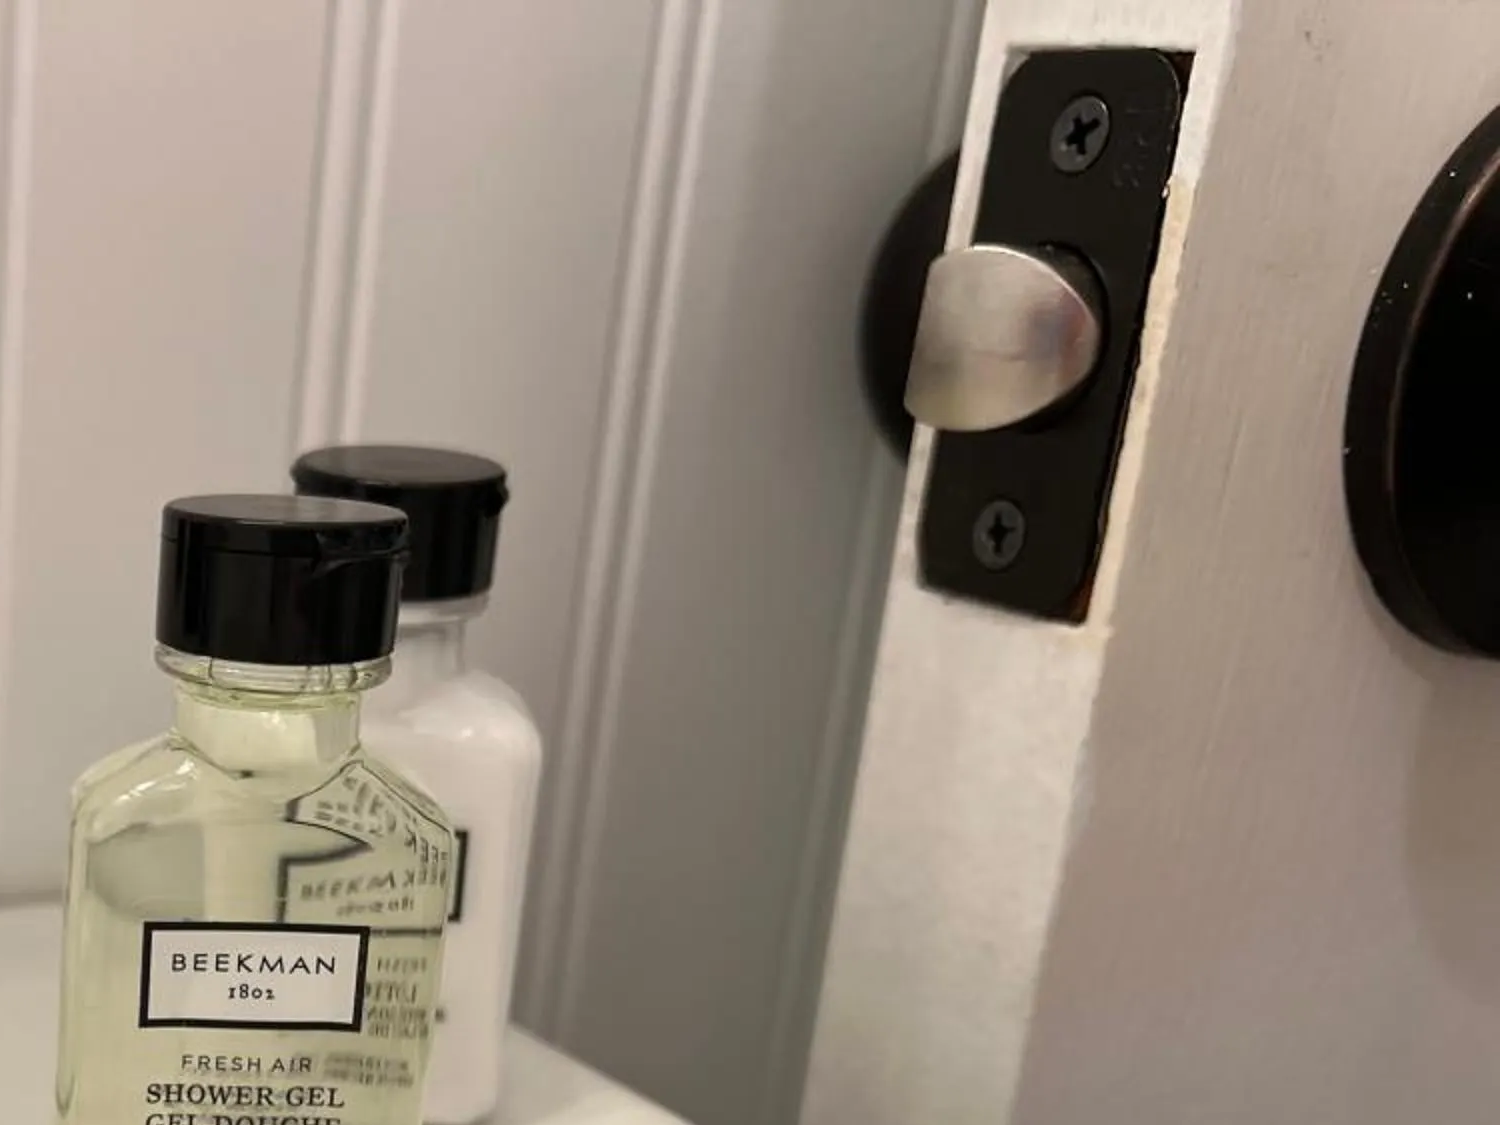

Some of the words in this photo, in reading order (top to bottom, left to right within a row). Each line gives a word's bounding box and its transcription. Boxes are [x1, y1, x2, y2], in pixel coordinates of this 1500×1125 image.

[171, 953, 336, 974] BEEKMAN
[228, 983, 275, 1001] 1802
[181, 1053, 262, 1074] FRESH
[271, 1056, 313, 1073] AIR
[146, 1083, 275, 1108] SHOWER
[285, 1085, 345, 1109] GEL
